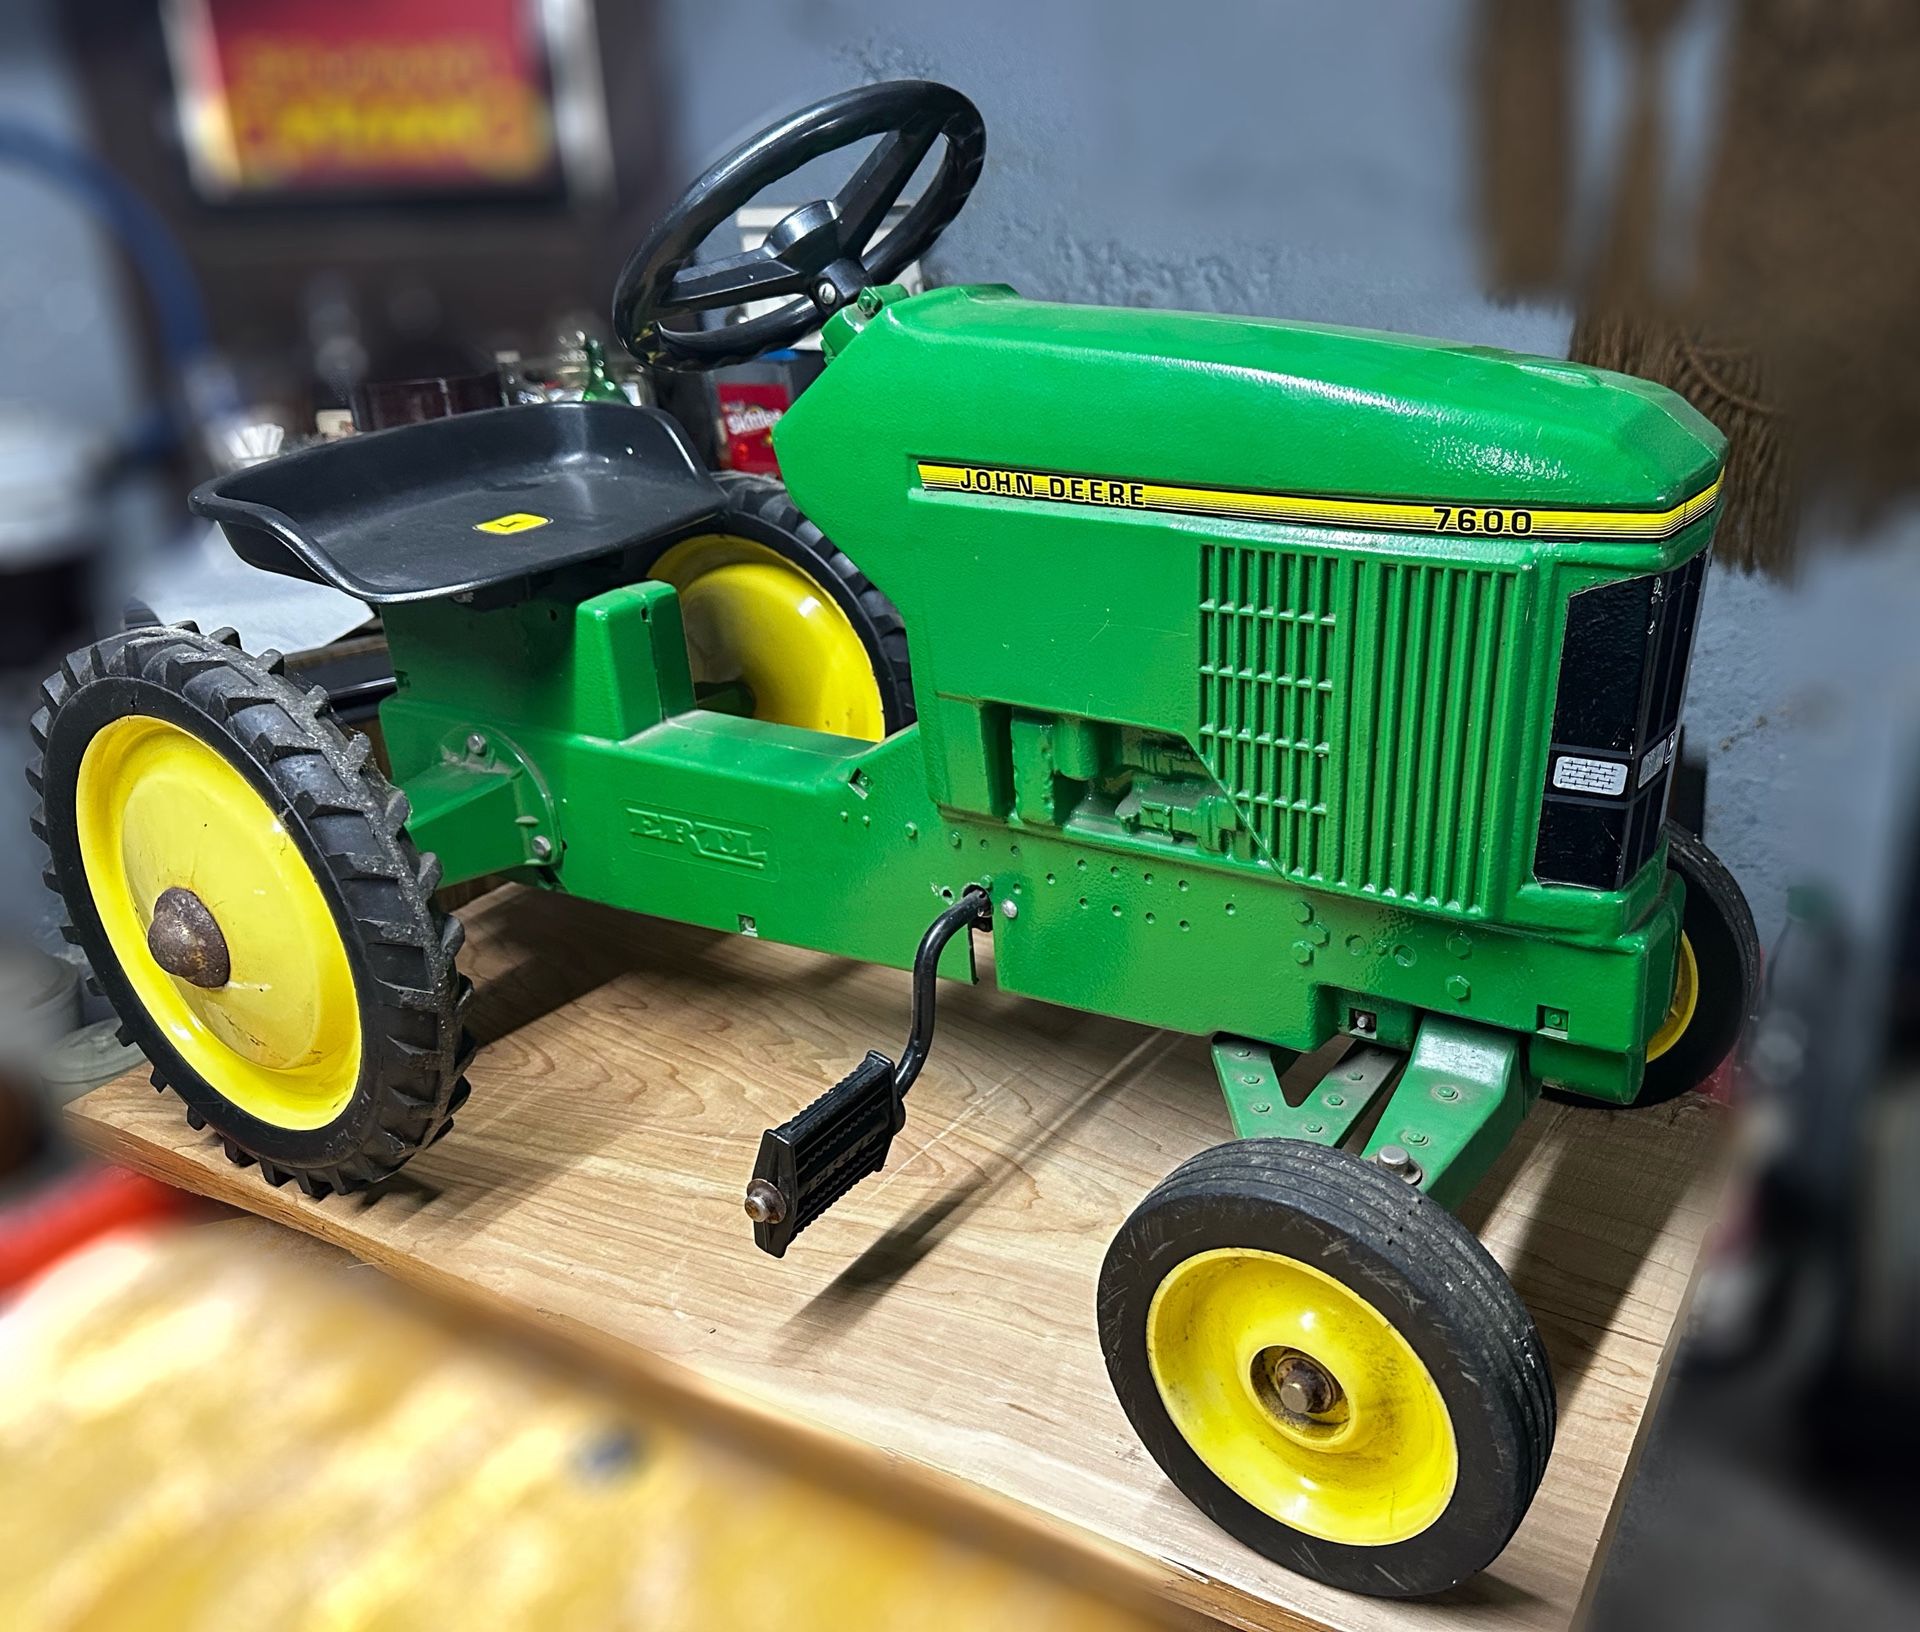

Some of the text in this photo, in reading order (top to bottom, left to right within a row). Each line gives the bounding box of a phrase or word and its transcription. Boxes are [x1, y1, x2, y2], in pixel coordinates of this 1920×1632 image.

[960, 469, 1145, 507] JOHN DEERE
[1433, 507, 1532, 535] 7600
[626, 808, 767, 870] ERTL
